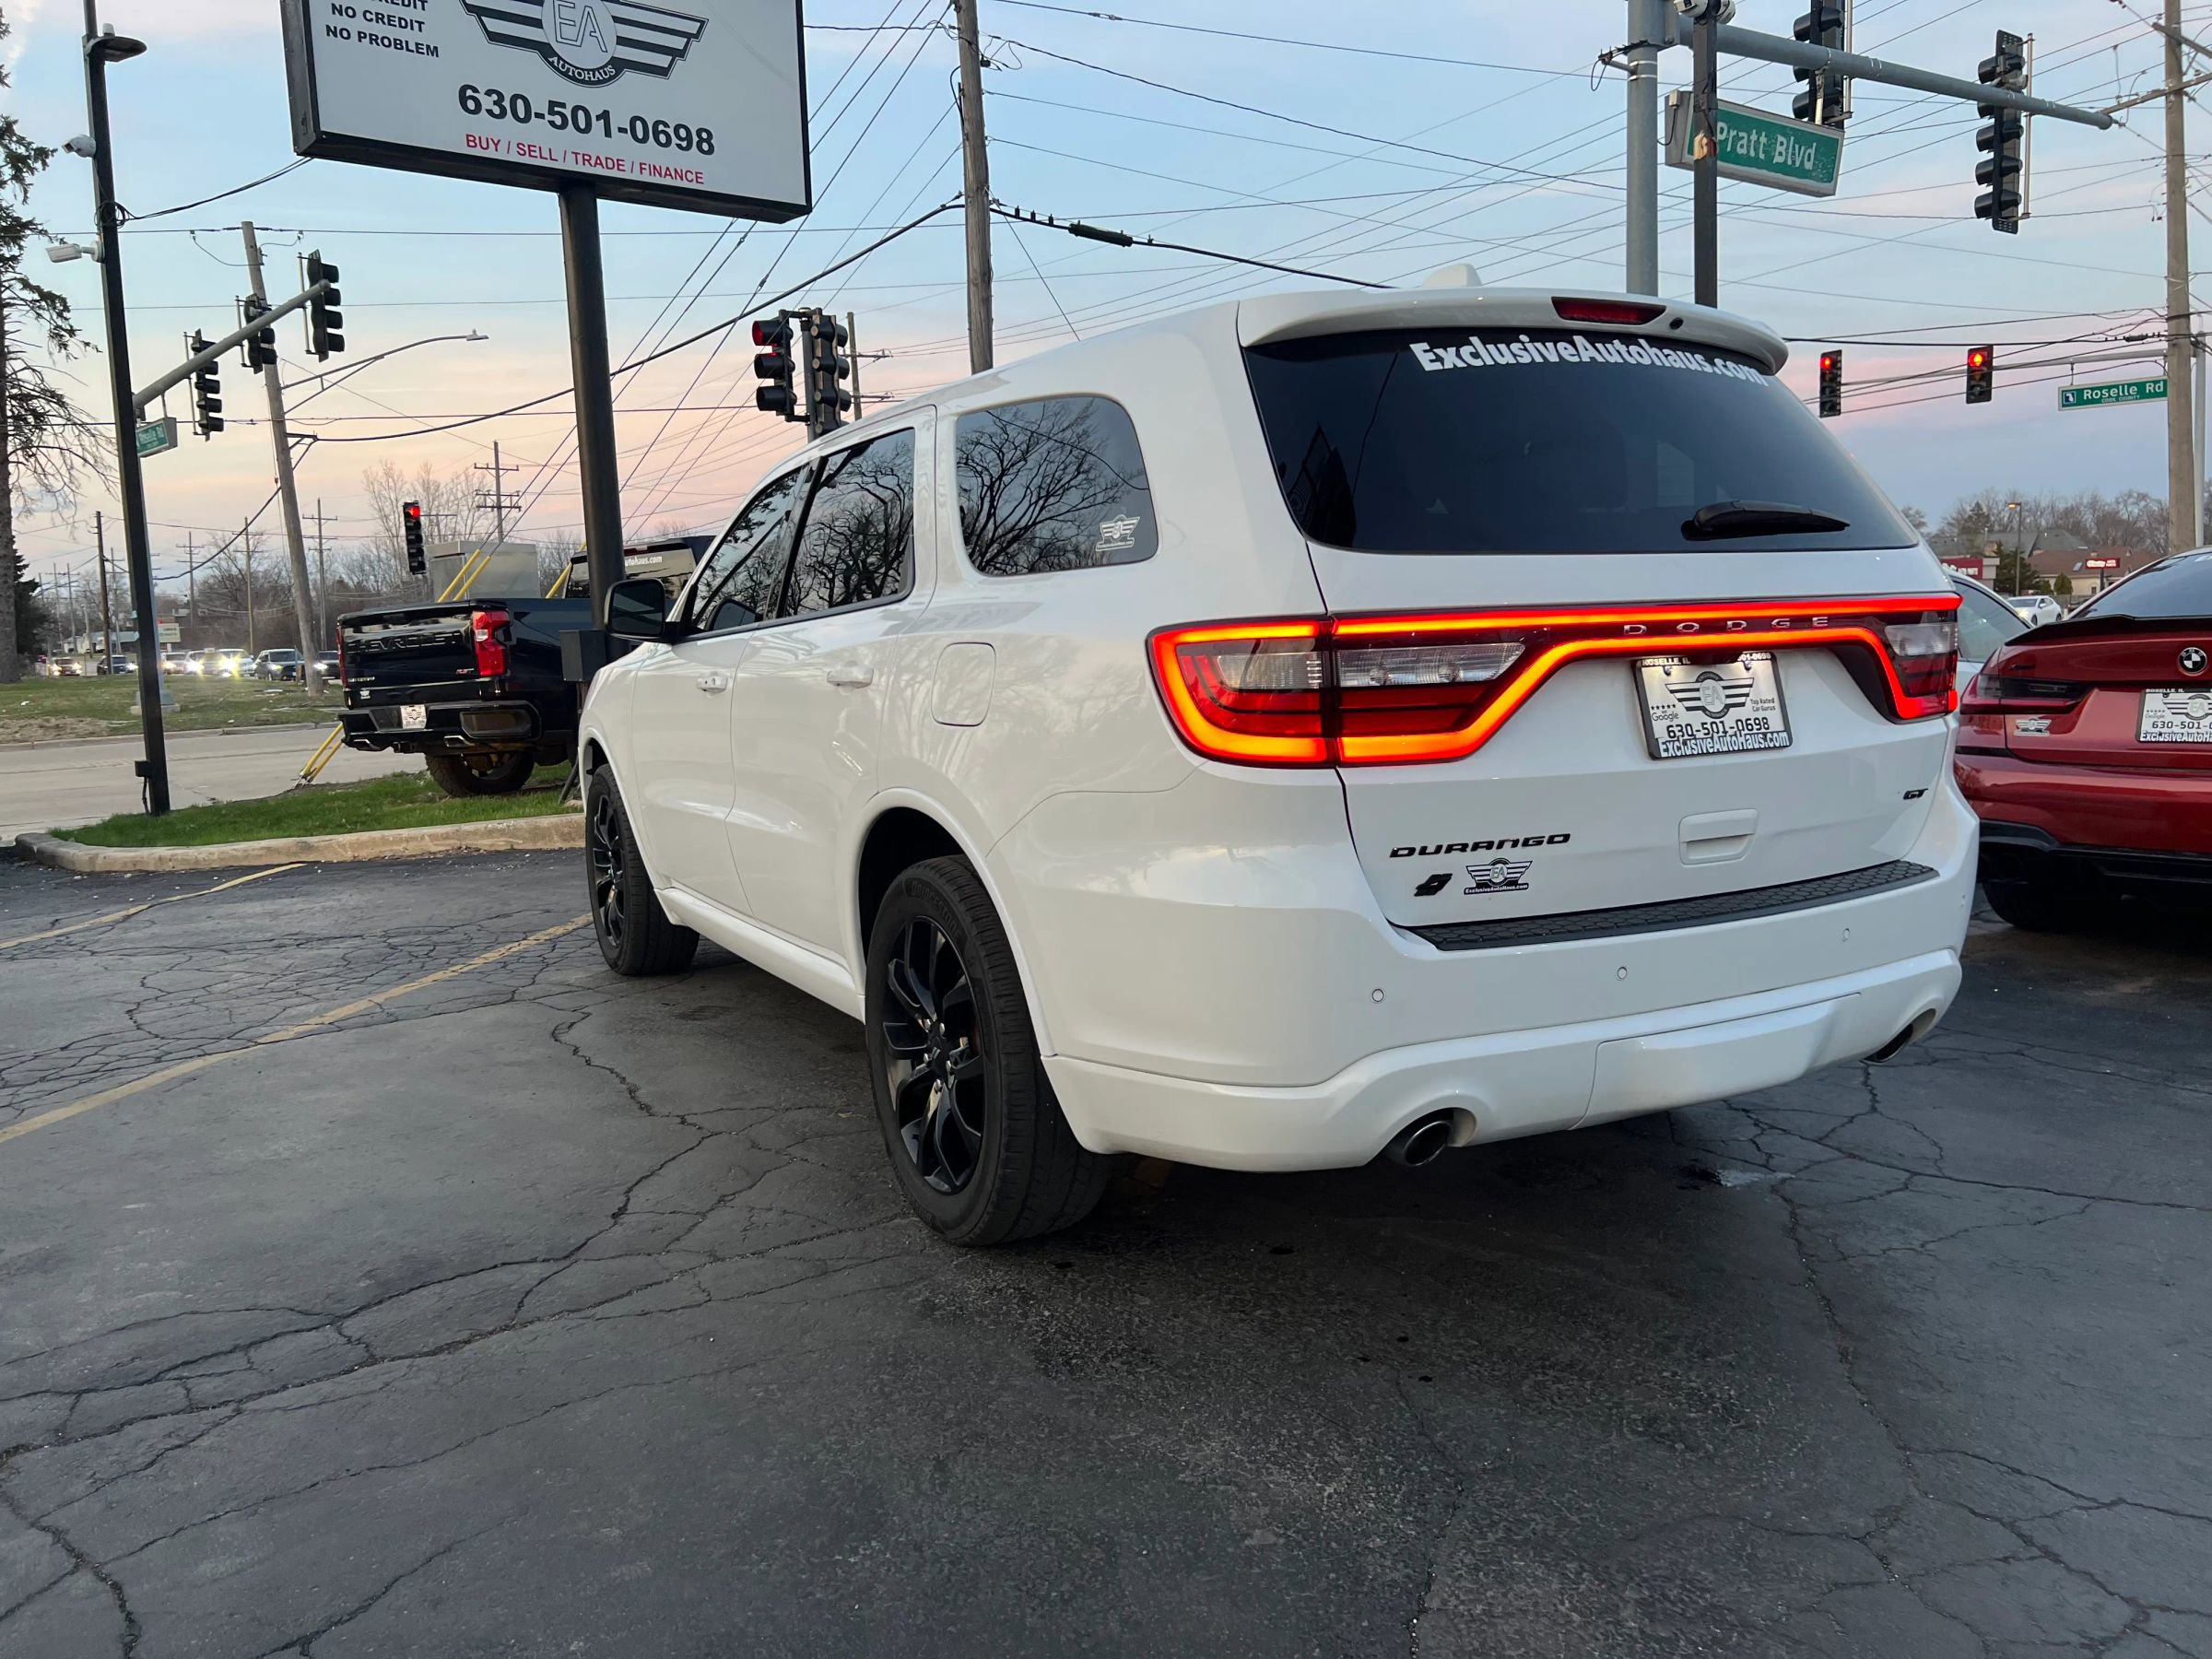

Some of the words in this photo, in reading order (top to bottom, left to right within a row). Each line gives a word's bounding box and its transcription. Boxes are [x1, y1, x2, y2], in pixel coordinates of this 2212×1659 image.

[331, 3, 357, 18] NO
[362, 9, 426, 33] CREDIT
[553, 0, 608, 53] EA
[325, 24, 351, 41] NO
[357, 30, 440, 58] PROBLEM
[547, 56, 616, 81] AUTOHAUS
[458, 84, 715, 156] 630-501-0698
[1716, 121, 1768, 160] Pratt
[1772, 135, 1818, 171] Blvd
[465, 134, 500, 152] BUY
[516, 142, 559, 162] SELL
[571, 151, 626, 171] TRADE
[639, 162, 705, 184] FINANCE
[1409, 334, 1770, 386] ExclusiveAutohaus.com
[2084, 385, 2138, 400] Roselle
[2146, 381, 2164, 393] Rd
[625, 555, 663, 567] utohaus.com
[1623, 616, 1830, 635] DODGE
[1737, 652, 1771, 662] 01-0698
[1652, 712, 1679, 723] Google
[1666, 716, 1771, 739] 630-501-0698
[1659, 731, 1790, 758] ExclusiveAutoHaus.com
[1903, 788, 1928, 800] GT
[1390, 833, 1571, 858] DURANGO
